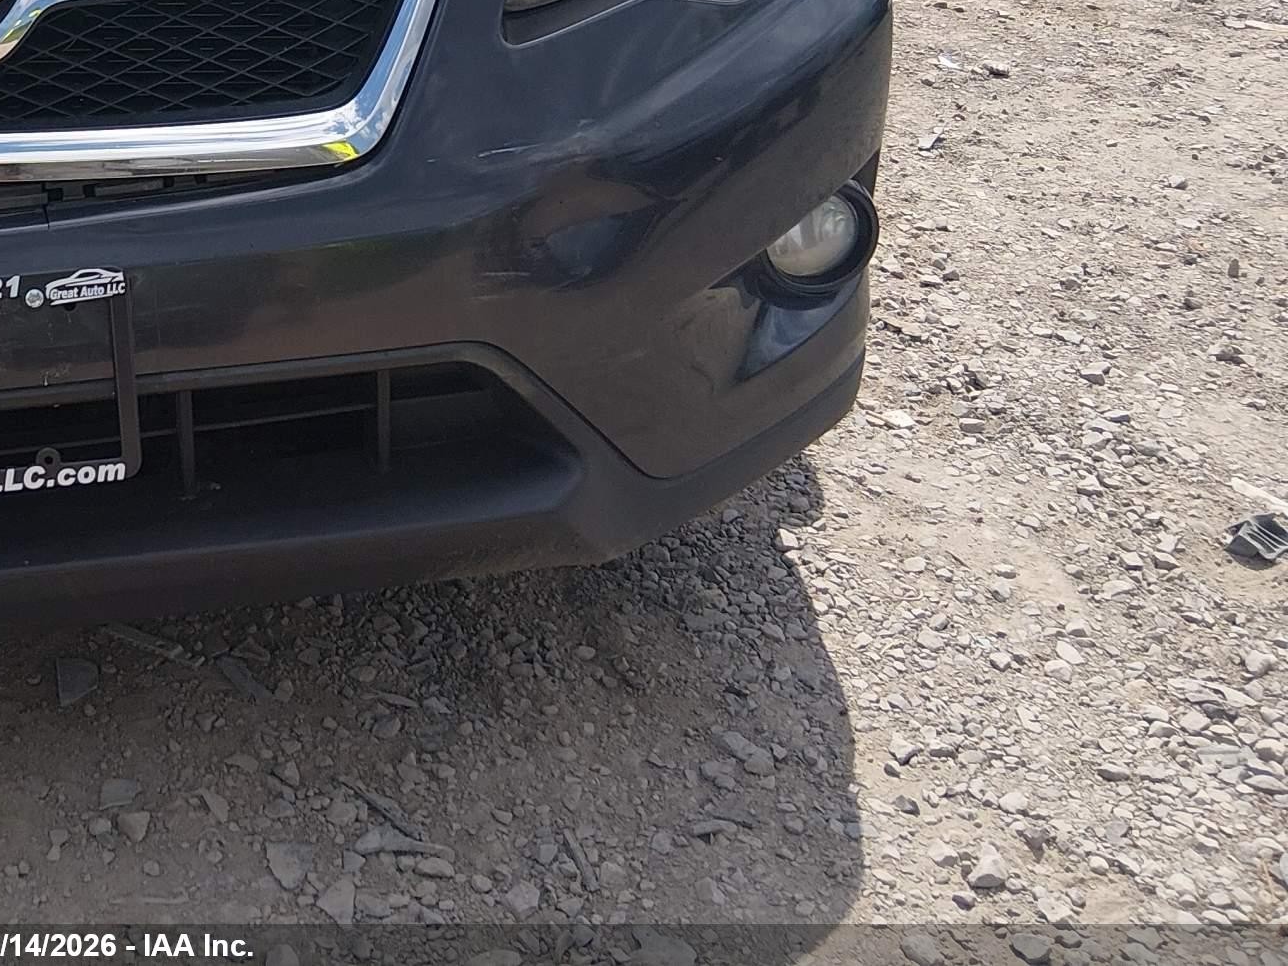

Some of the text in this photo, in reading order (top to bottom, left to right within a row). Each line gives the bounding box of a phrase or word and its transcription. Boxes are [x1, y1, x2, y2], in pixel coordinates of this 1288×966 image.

[50, 282, 126, 300] Great Auto LLC
